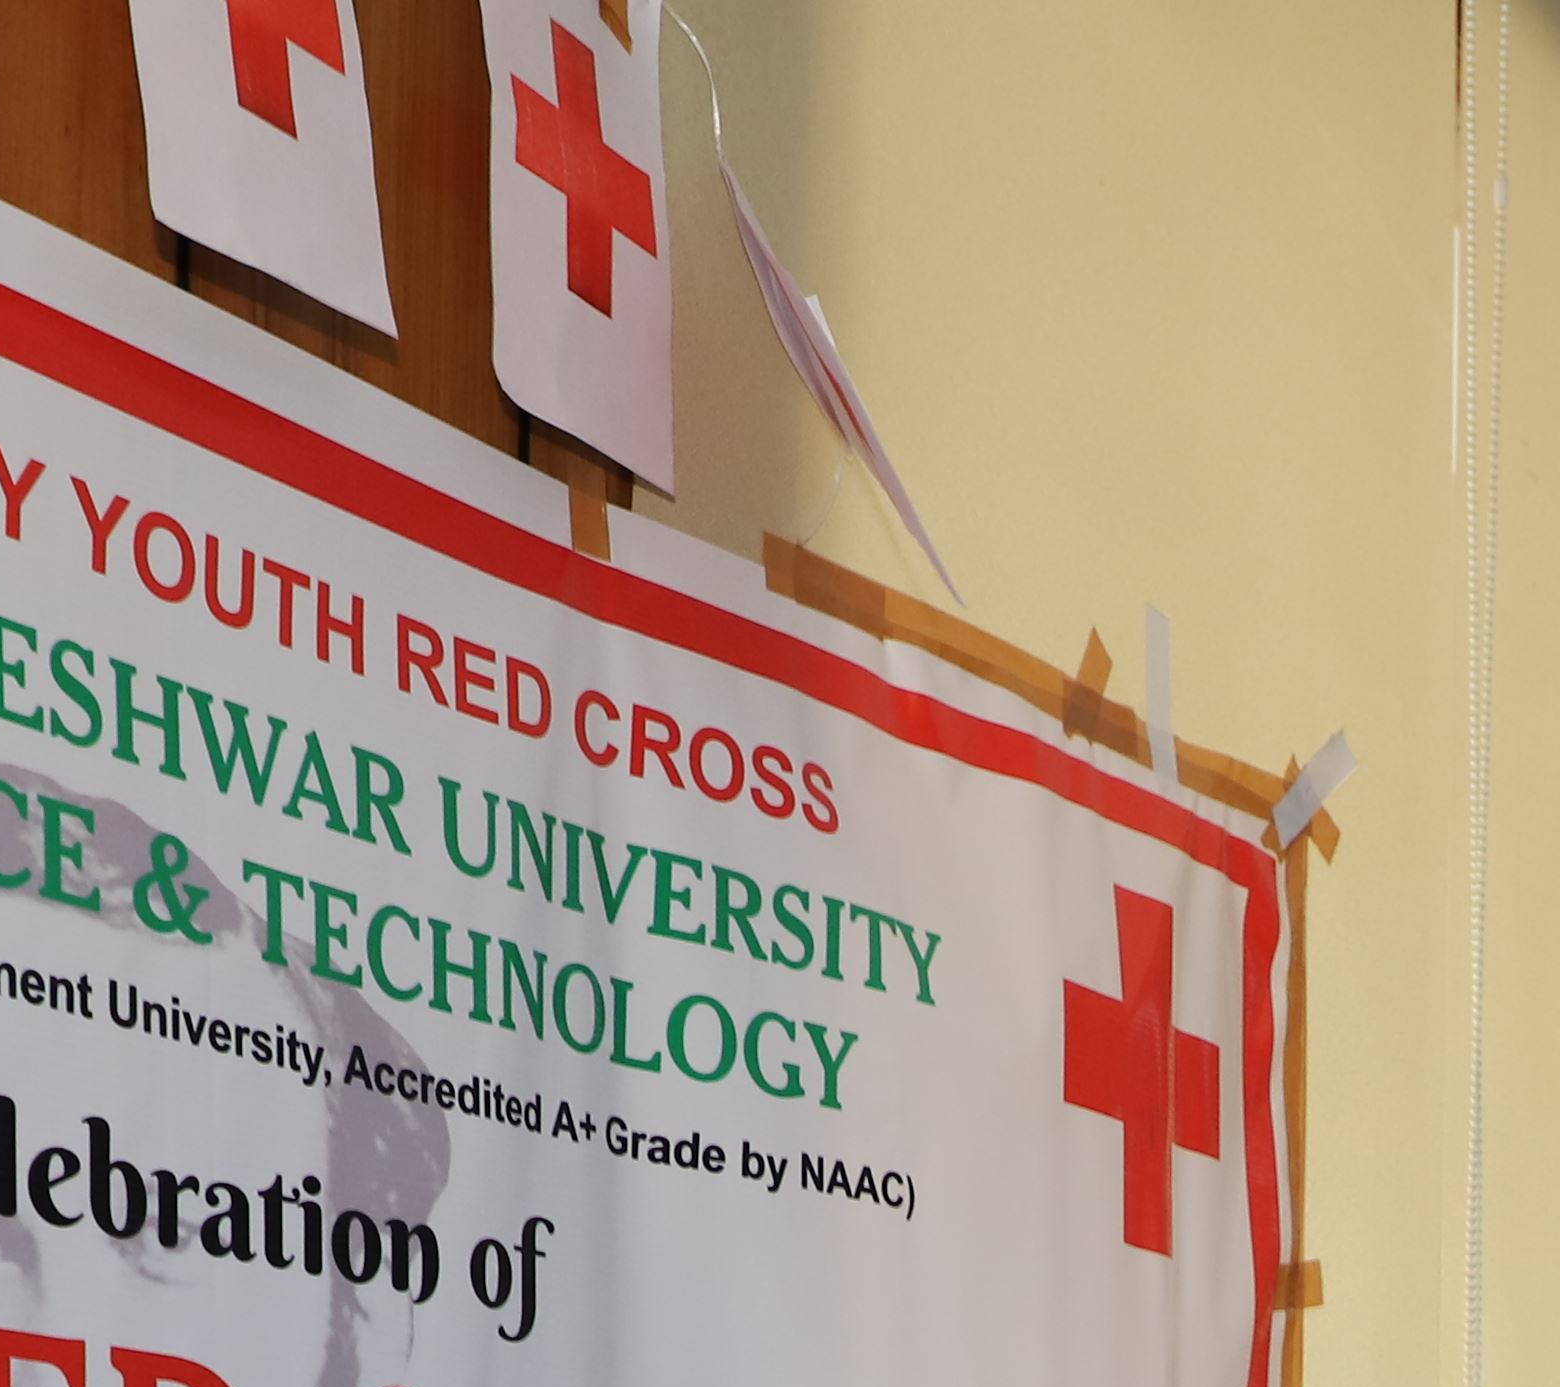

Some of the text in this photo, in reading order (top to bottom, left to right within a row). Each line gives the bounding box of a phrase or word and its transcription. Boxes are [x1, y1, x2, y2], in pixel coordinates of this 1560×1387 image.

[69, 474, 366, 677] YOUTH
[394, 613, 553, 740] RED
[573, 690, 841, 835] CROSS
[131, 832, 214, 946] &
[241, 860, 859, 1111] TECHNOLOGY
[437, 774, 942, 1006] UNIVERSITY
[108, 972, 334, 1088] University,
[344, 1044, 543, 1133] Accredited
[604, 1117, 727, 1177] Grade
[739, 1138, 789, 1195] by
[800, 1157, 918, 1222] NAAC)
[469, 1216, 556, 1343] of
